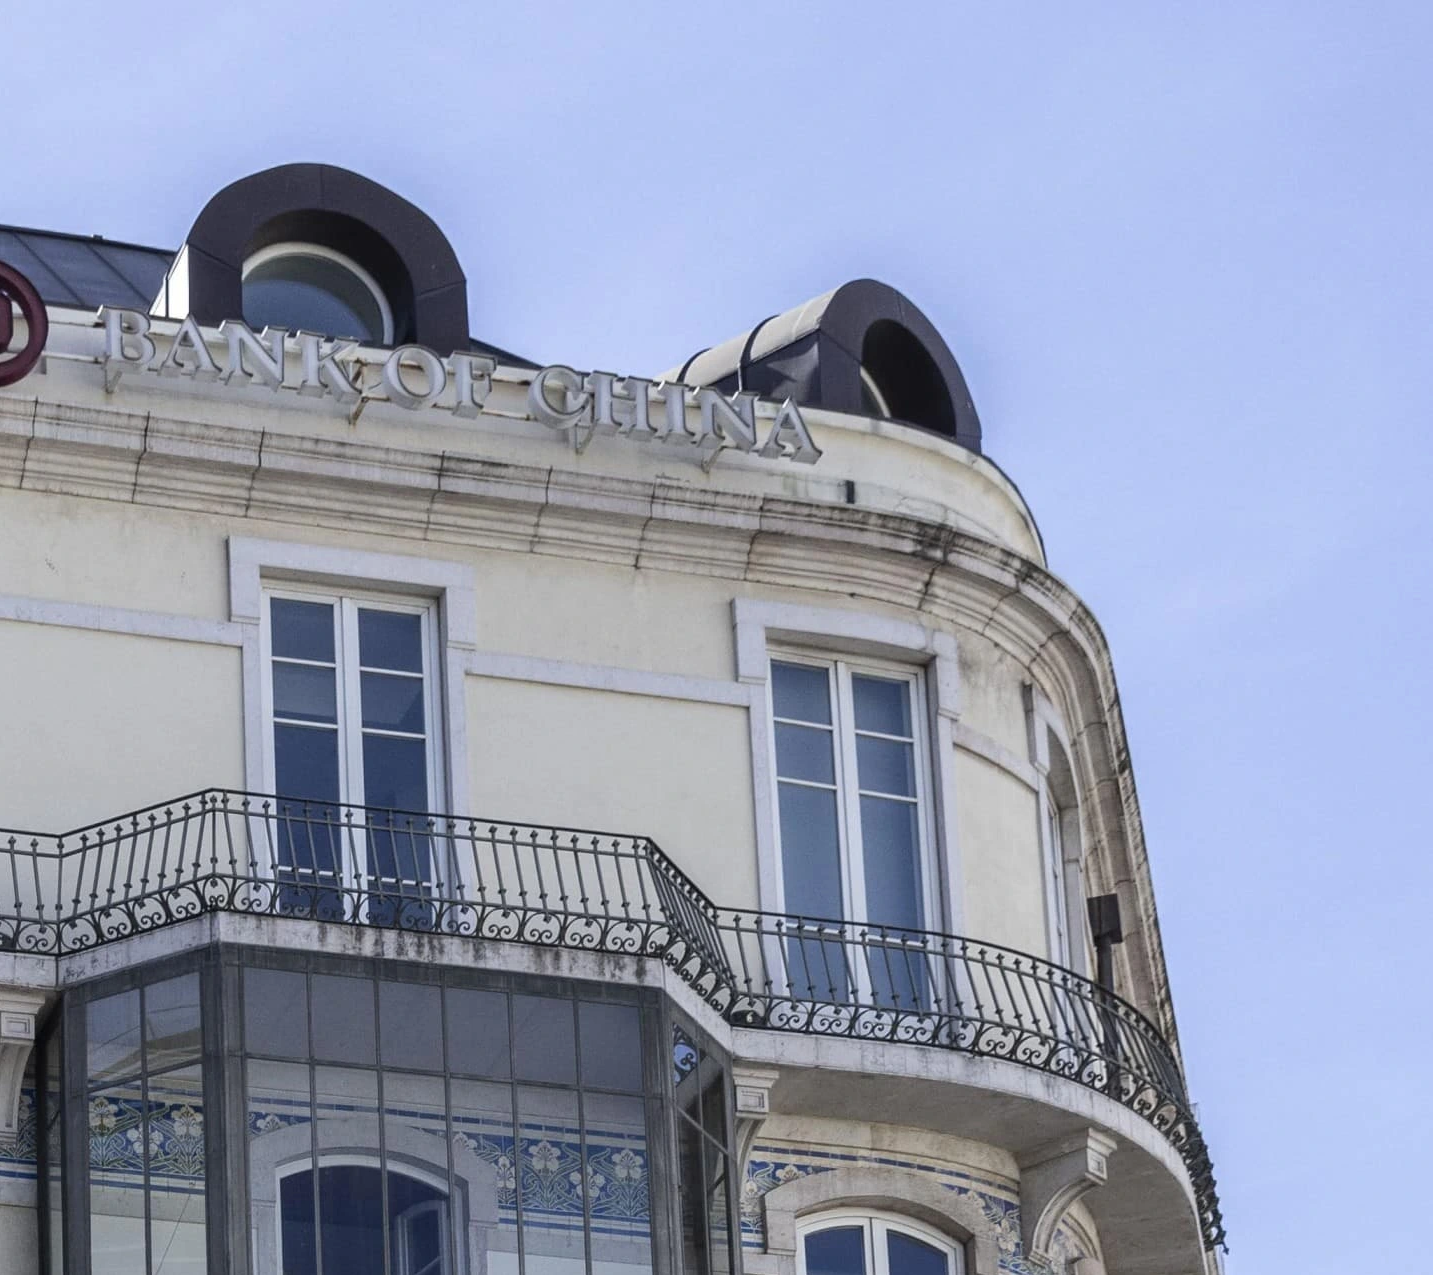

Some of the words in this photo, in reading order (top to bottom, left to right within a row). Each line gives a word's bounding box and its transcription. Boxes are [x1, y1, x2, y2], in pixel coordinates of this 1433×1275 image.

[96, 303, 363, 396] BANK
[383, 343, 497, 419] OF
[528, 364, 823, 465] CHINA
